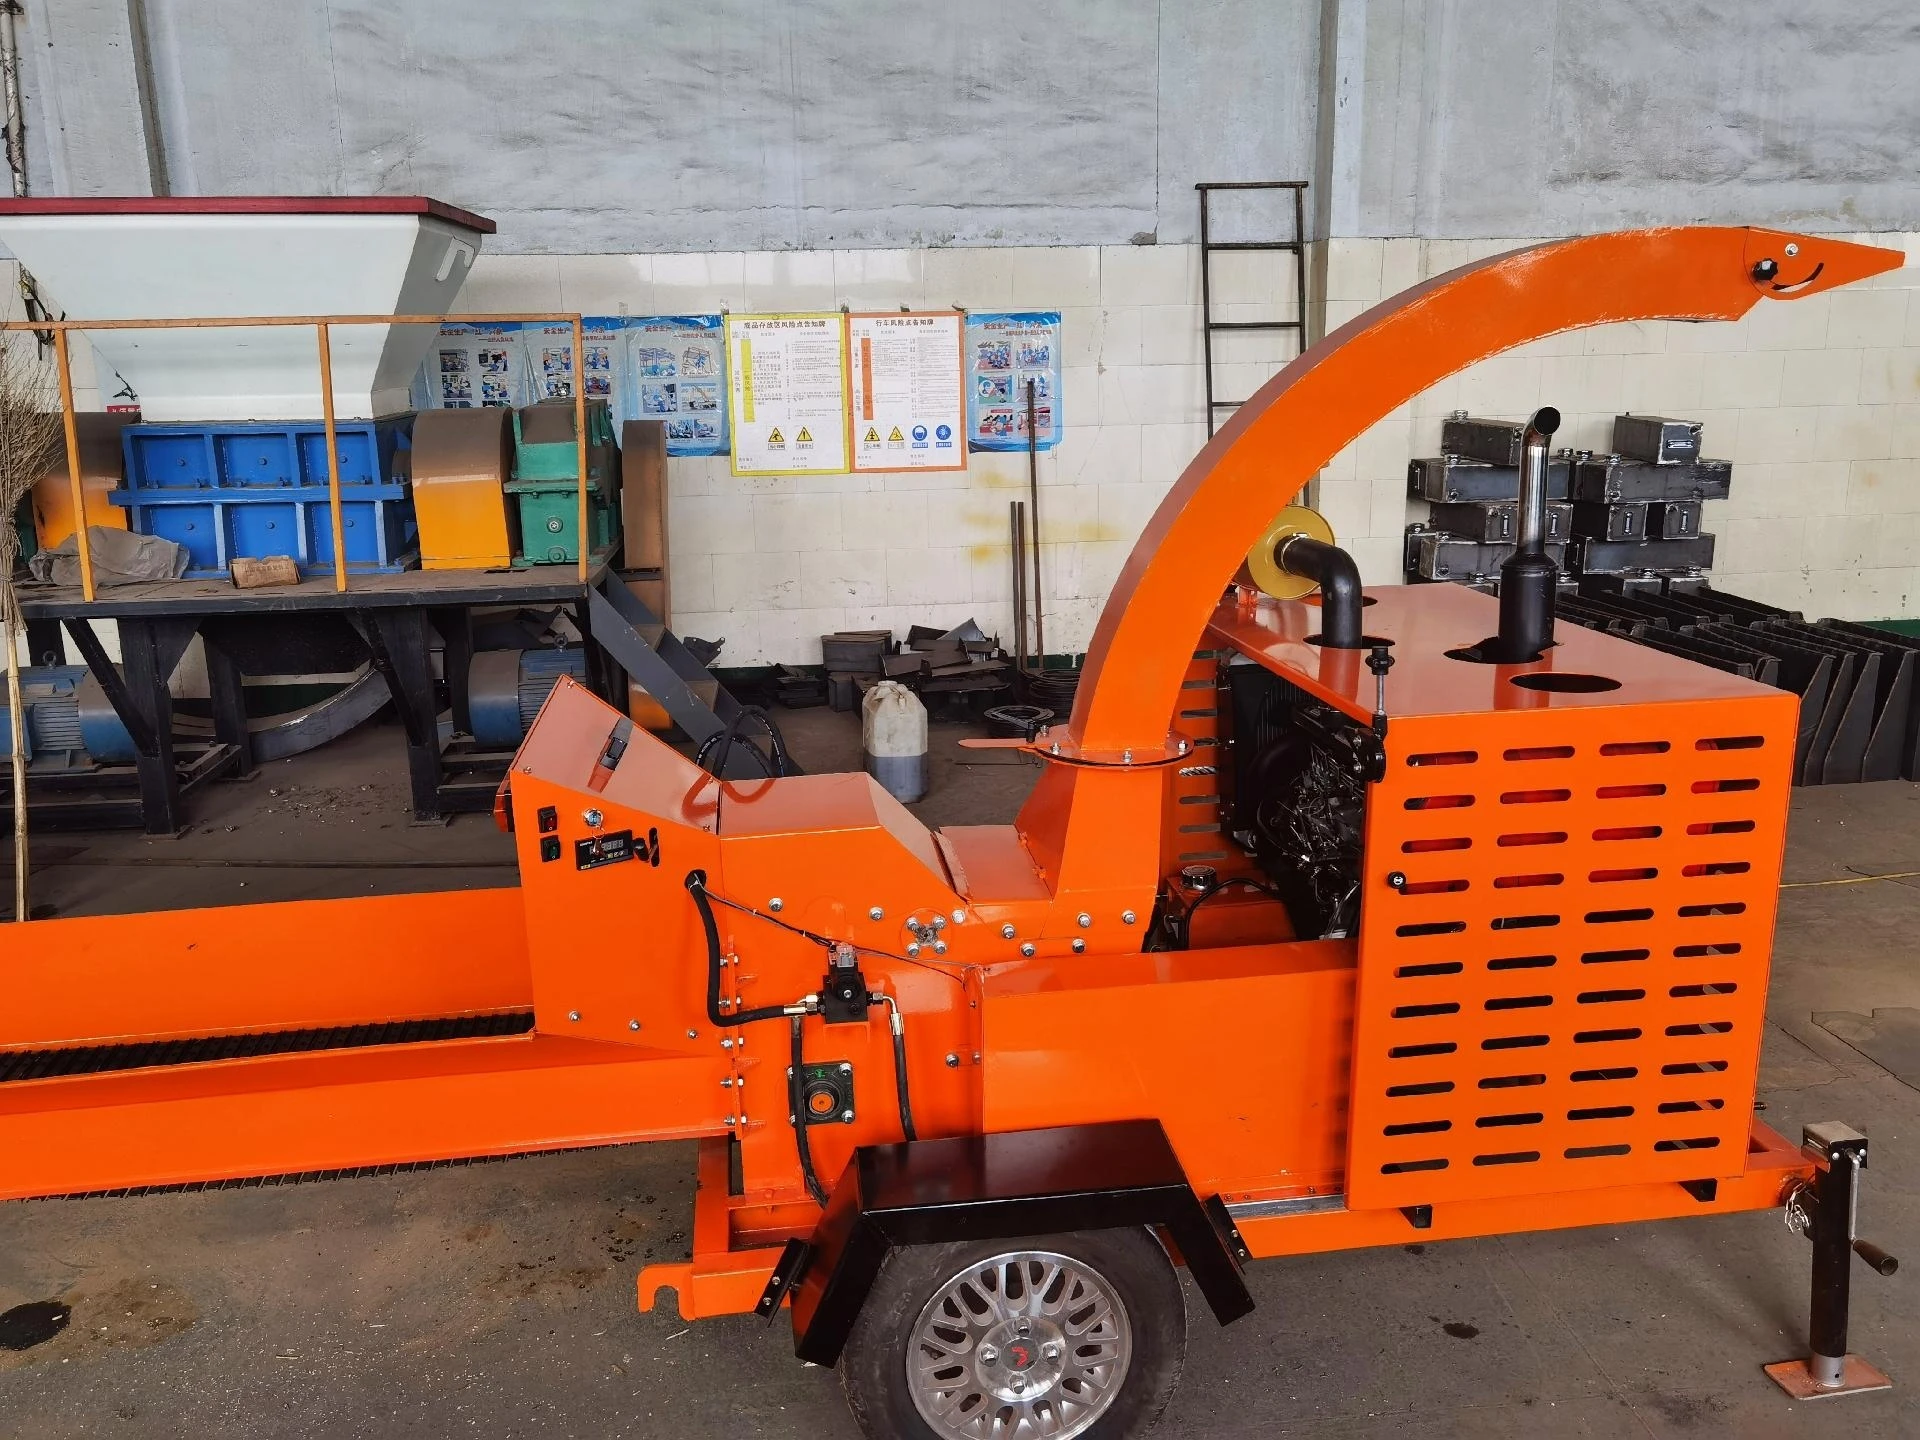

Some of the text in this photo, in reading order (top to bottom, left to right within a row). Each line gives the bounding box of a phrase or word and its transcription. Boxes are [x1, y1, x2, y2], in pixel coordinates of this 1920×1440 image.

[875, 318, 935, 327] 行车风险点告知牌
